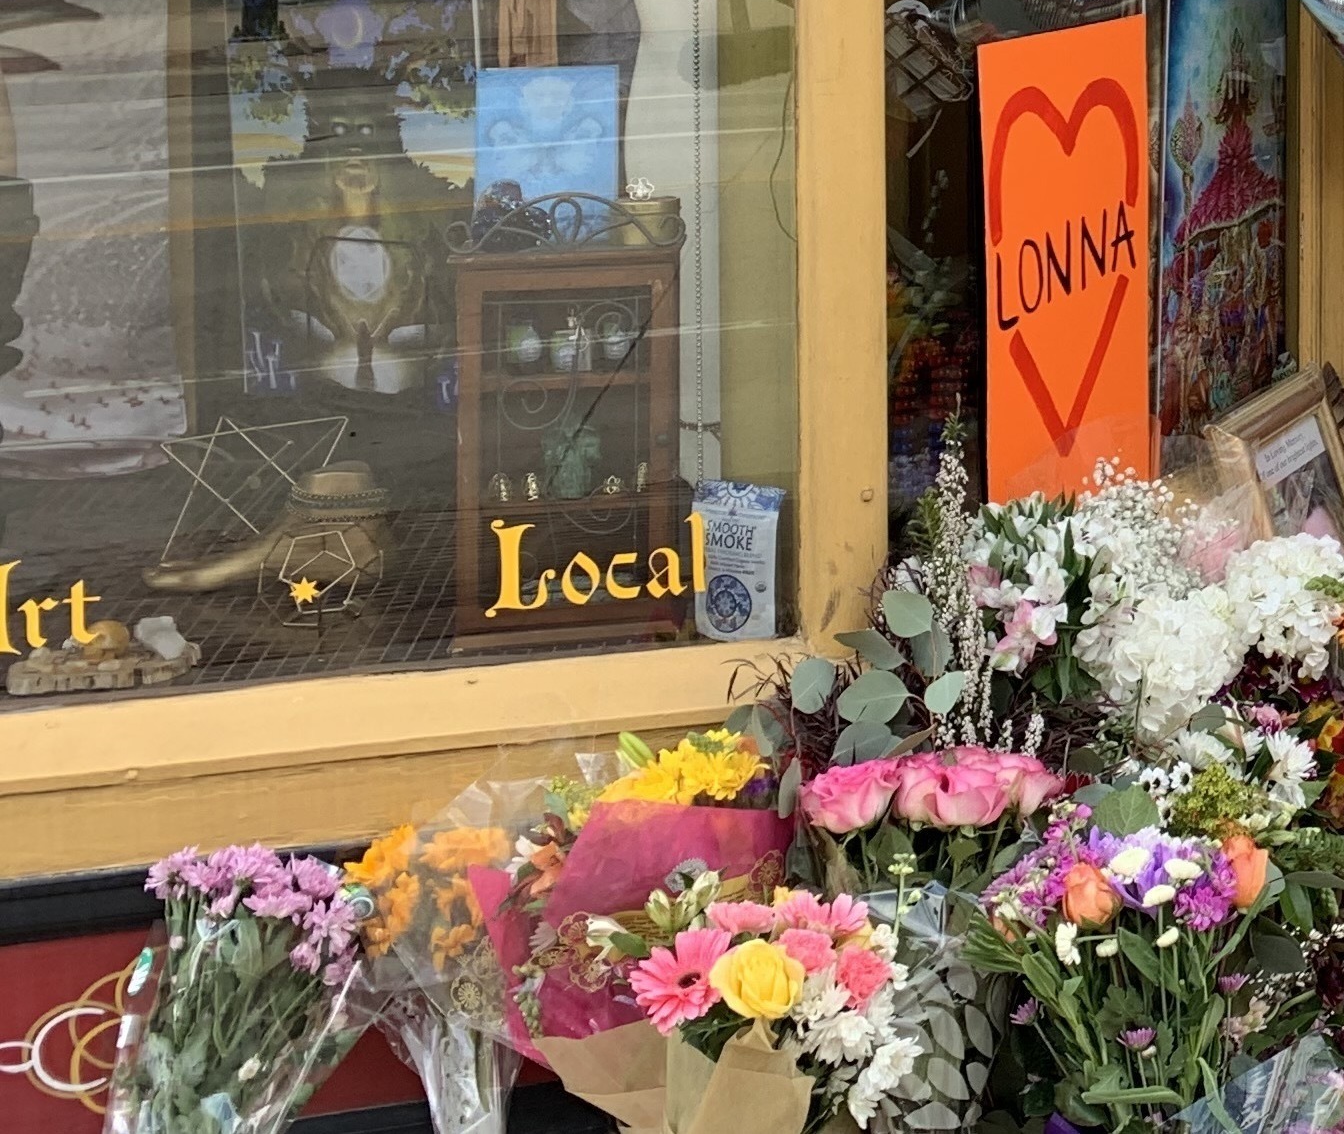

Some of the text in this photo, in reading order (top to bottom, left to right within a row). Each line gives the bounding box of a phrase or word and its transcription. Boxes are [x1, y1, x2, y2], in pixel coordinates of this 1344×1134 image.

[996, 200, 1137, 331] LONNA
[705, 533, 752, 551] SMOKE
[706, 519, 754, 536] SMOOTH
[485, 510, 706, 619] Local
